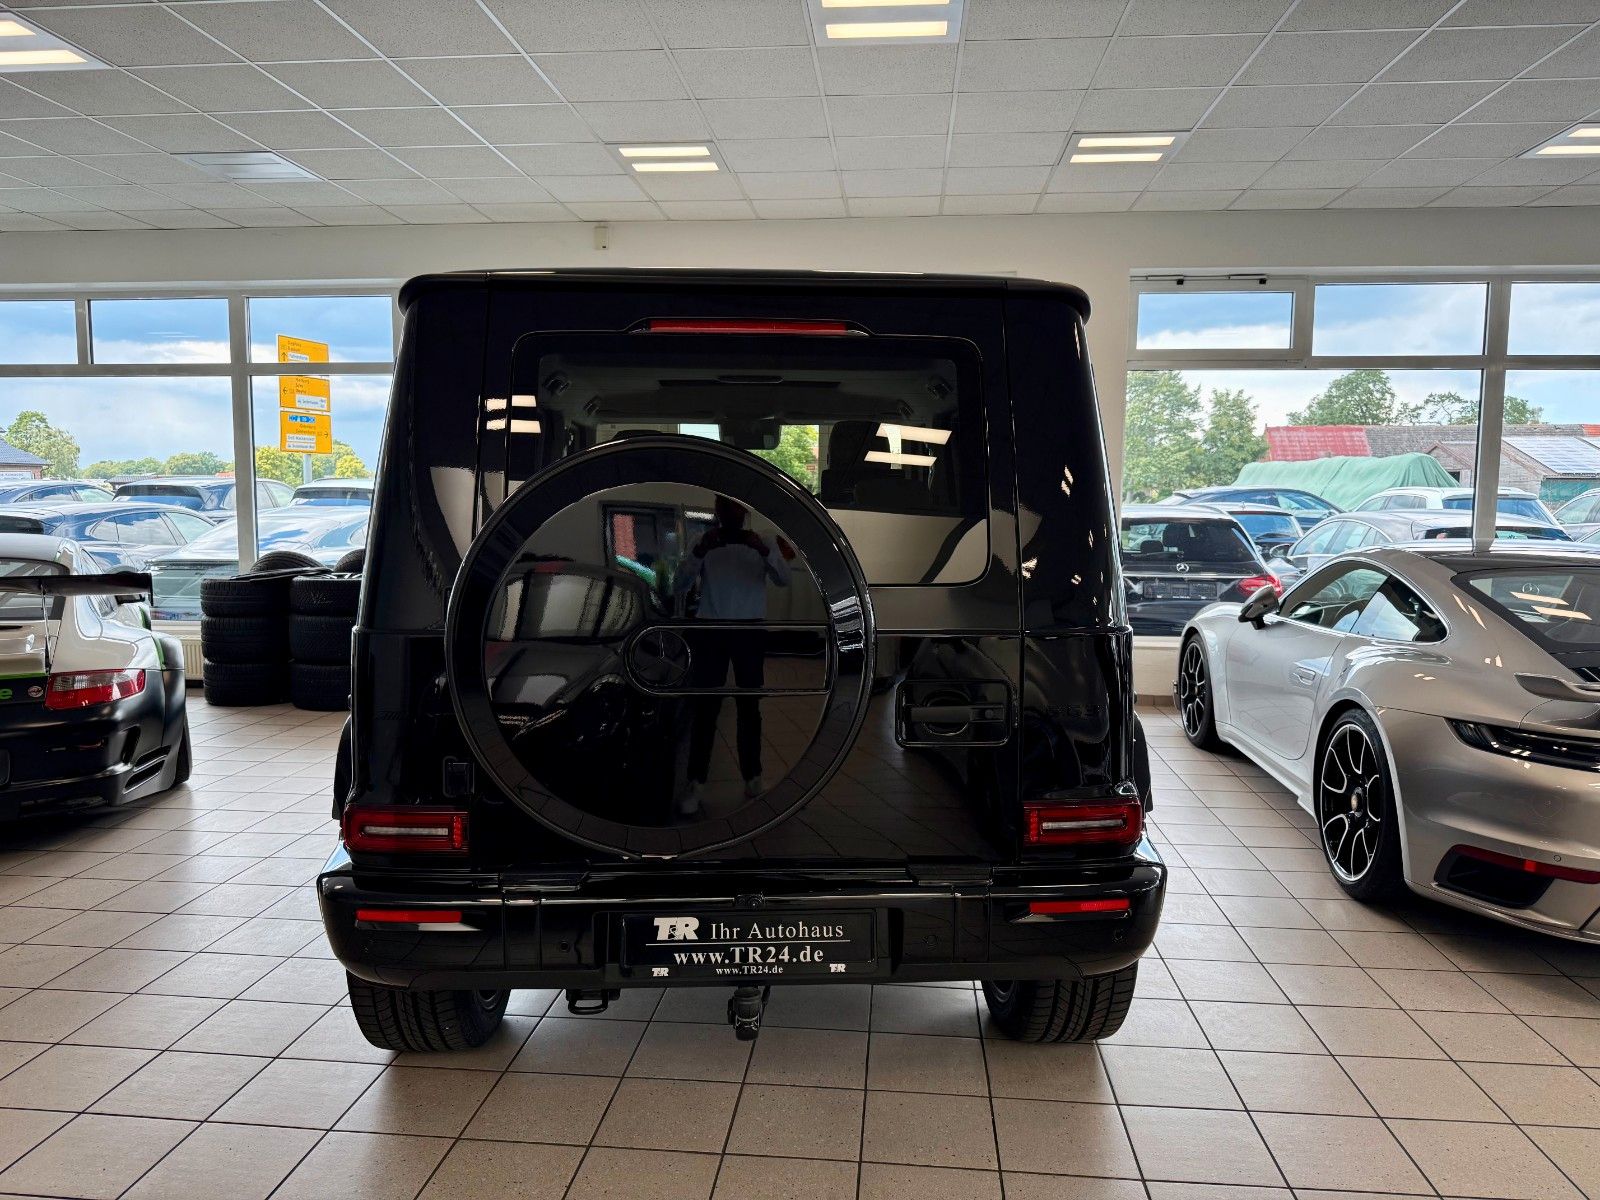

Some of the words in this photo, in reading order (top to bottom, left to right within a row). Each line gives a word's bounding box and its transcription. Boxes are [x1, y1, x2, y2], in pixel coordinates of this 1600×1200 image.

[710, 922, 741, 940] Ihr
[747, 920, 844, 940] Autohaus
[673, 945, 825, 965] www.TR24.de
[715, 965, 784, 976] www.TR24.de
